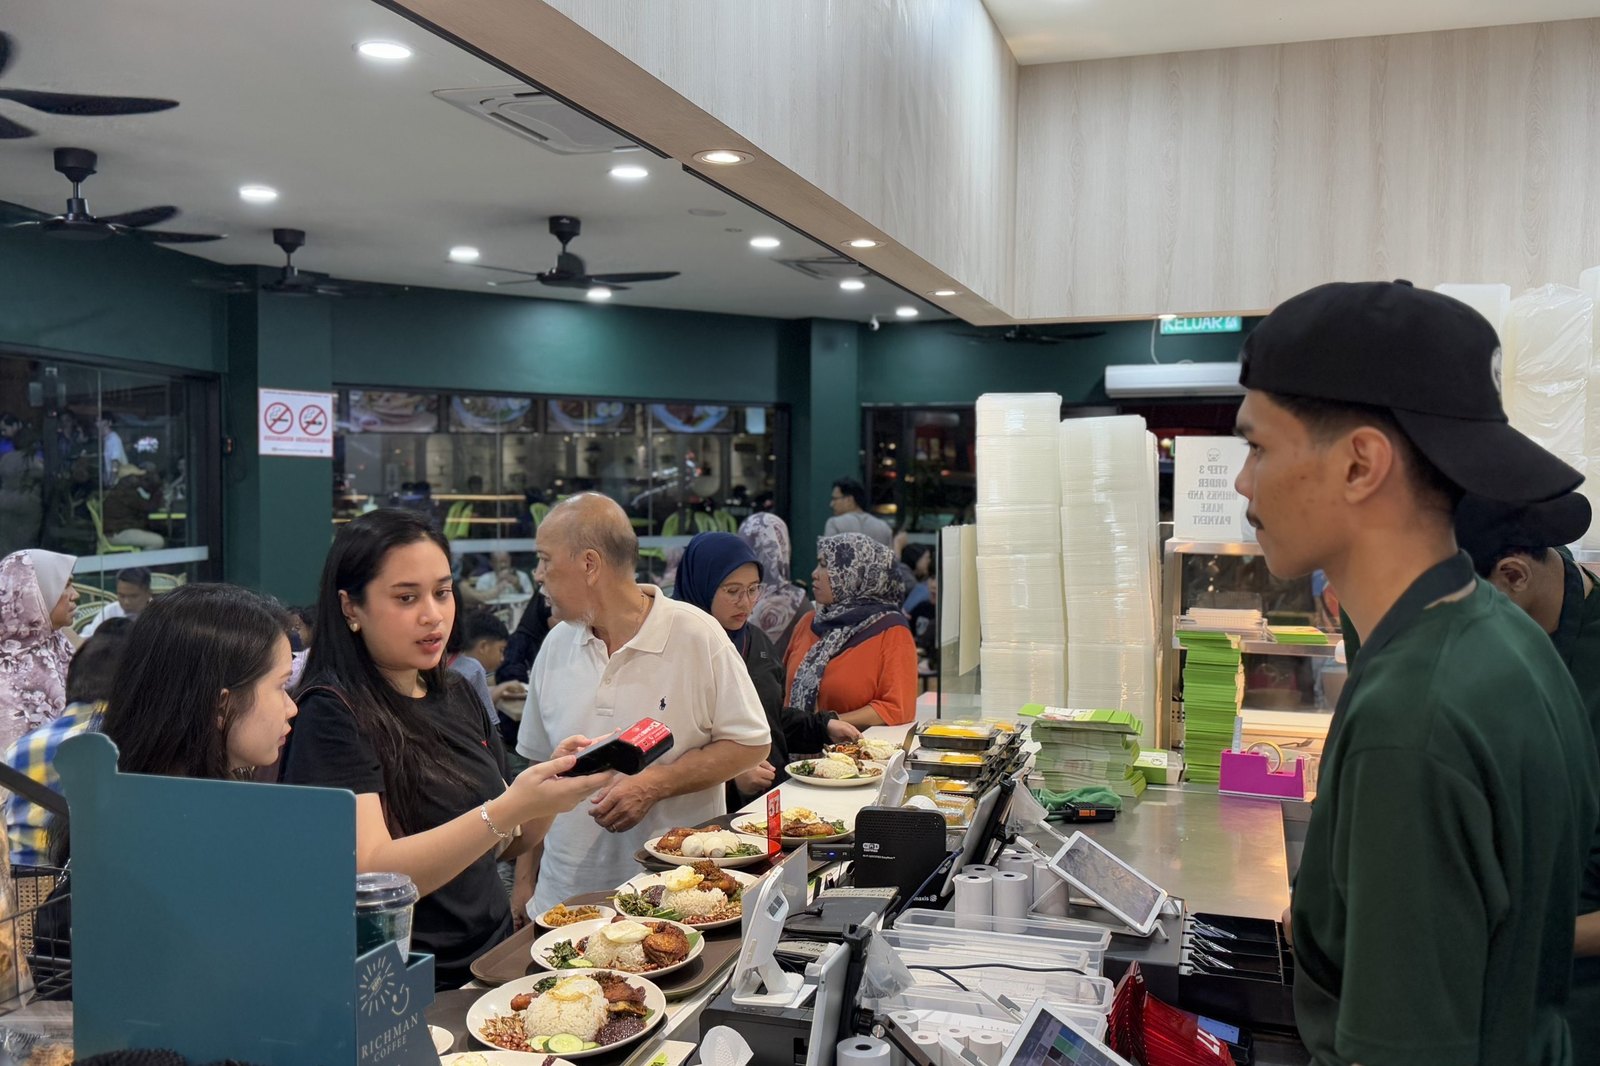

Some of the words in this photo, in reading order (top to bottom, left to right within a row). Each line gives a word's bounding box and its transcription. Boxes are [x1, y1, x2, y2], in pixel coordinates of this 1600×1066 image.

[1164, 317, 1223, 331] KELUAR
[361, 1012, 419, 1059] RICHMAN
[374, 1034, 407, 1062] COFFEE
[1196, 1028, 1220, 1056] 17
